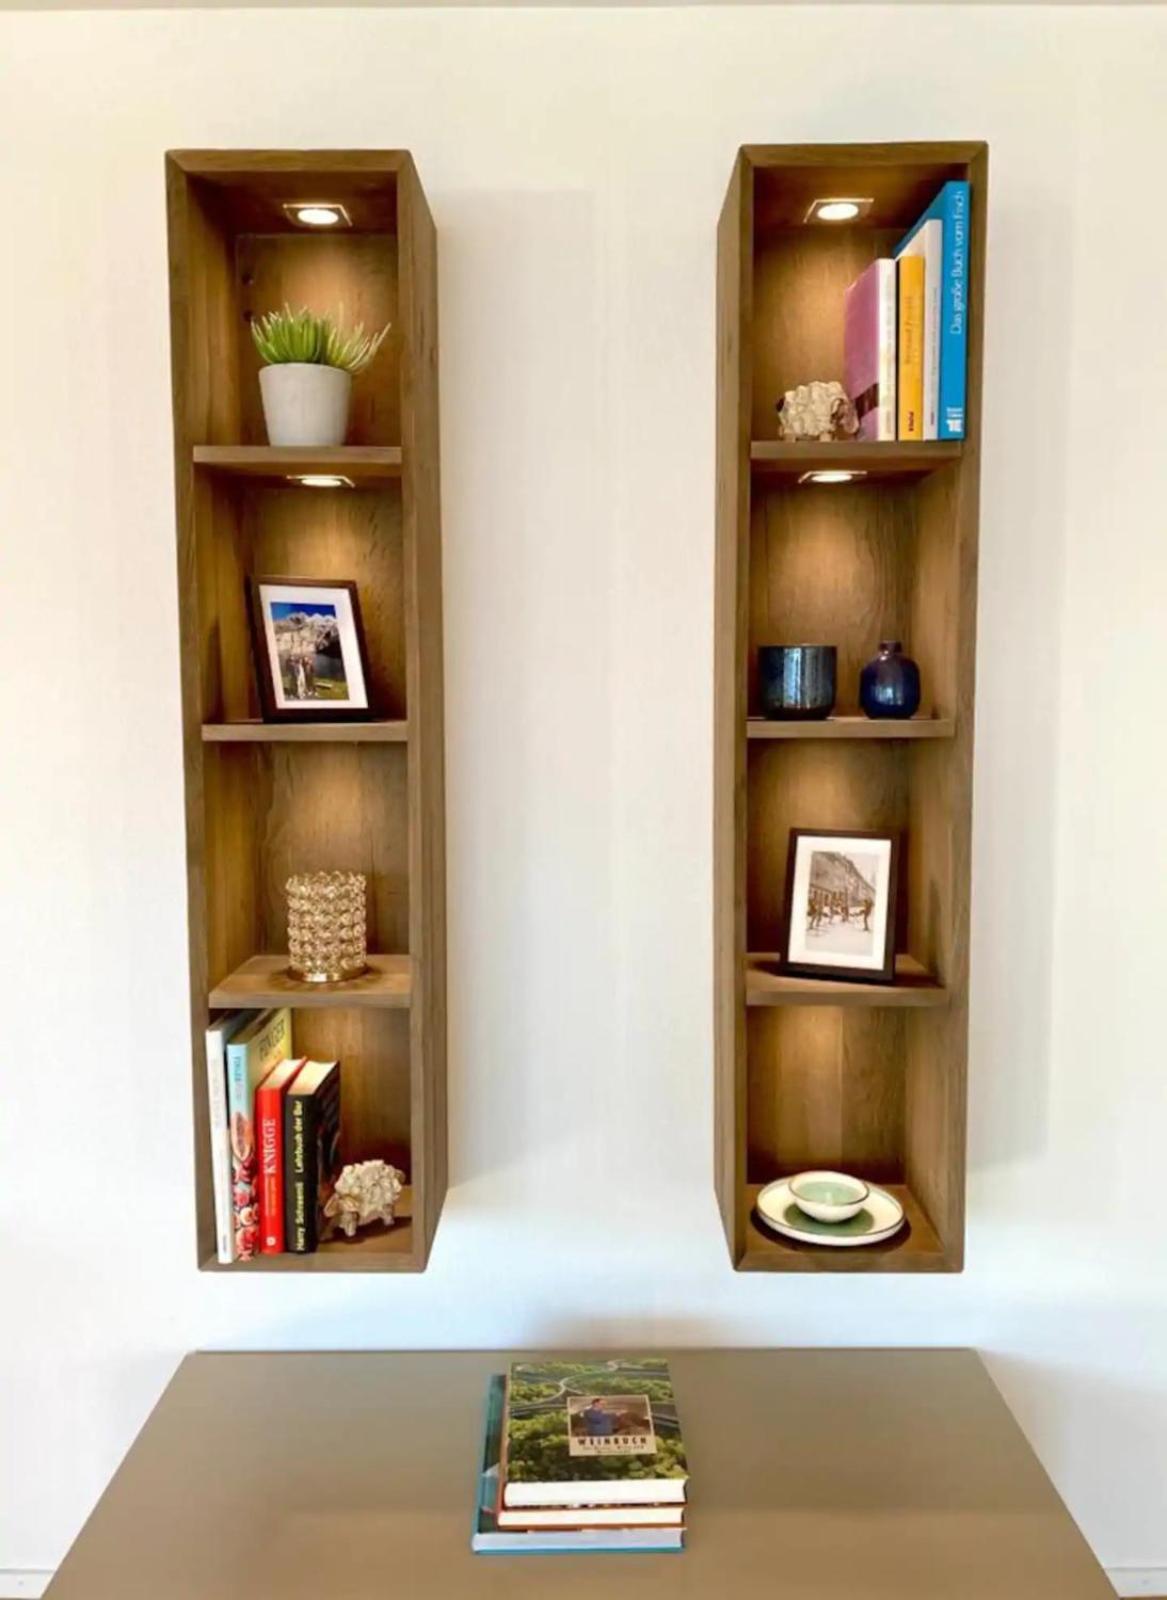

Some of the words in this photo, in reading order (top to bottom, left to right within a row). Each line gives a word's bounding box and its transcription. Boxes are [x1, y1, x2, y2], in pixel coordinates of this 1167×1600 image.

[954, 221, 965, 247] vom
[952, 248, 964, 278] Buch
[952, 279, 966, 312] große
[951, 313, 963, 335] Das
[293, 1100, 304, 1116] Bar
[293, 1117, 304, 1132] der
[262, 1118, 277, 1175] KNIGGE
[293, 1133, 304, 1173] Lehrbuch
[294, 1226, 306, 1251] Harry
[577, 1437, 647, 1446] WEINBUCH
